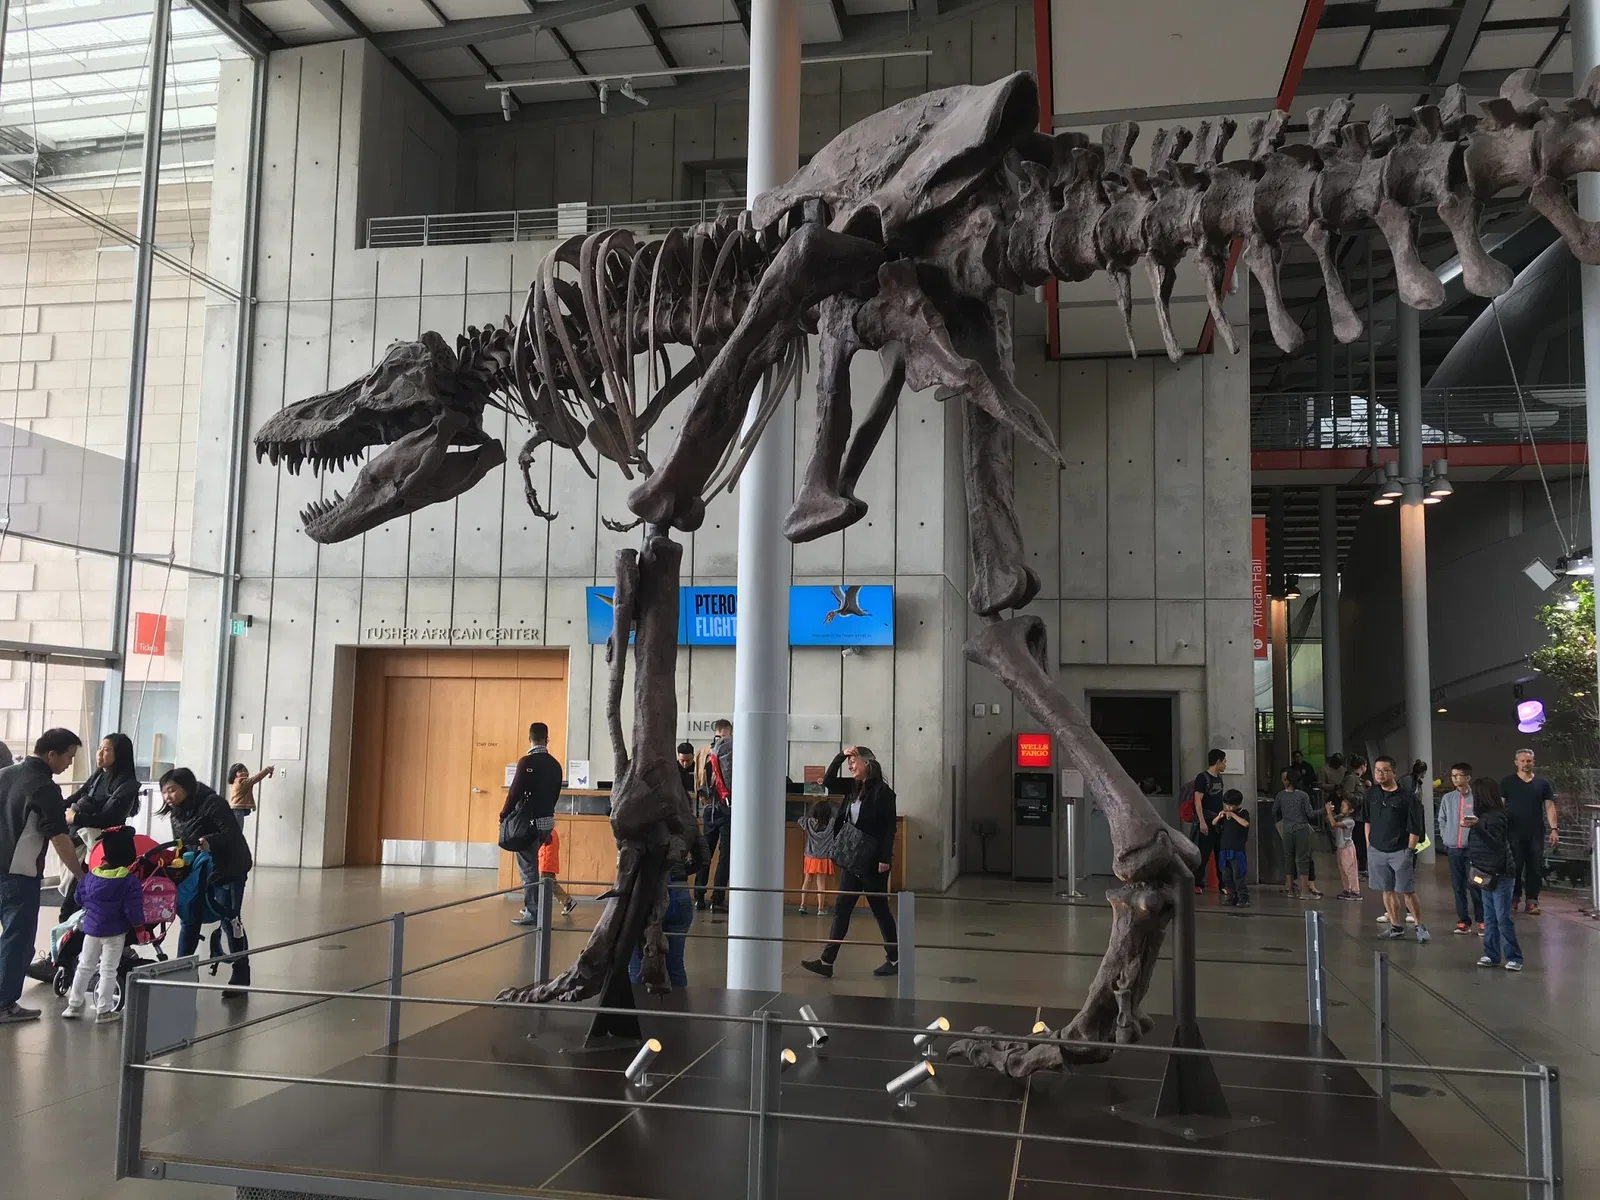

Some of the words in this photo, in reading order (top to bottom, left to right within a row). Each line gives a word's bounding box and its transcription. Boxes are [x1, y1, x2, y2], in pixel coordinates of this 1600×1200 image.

[1252, 560, 1262, 581] Hall
[695, 594, 737, 615] PTERO
[1252, 583, 1263, 627] African
[365, 628, 417, 640] TUSHER
[421, 628, 482, 640] AFRICAN
[485, 628, 540, 640] CENTER
